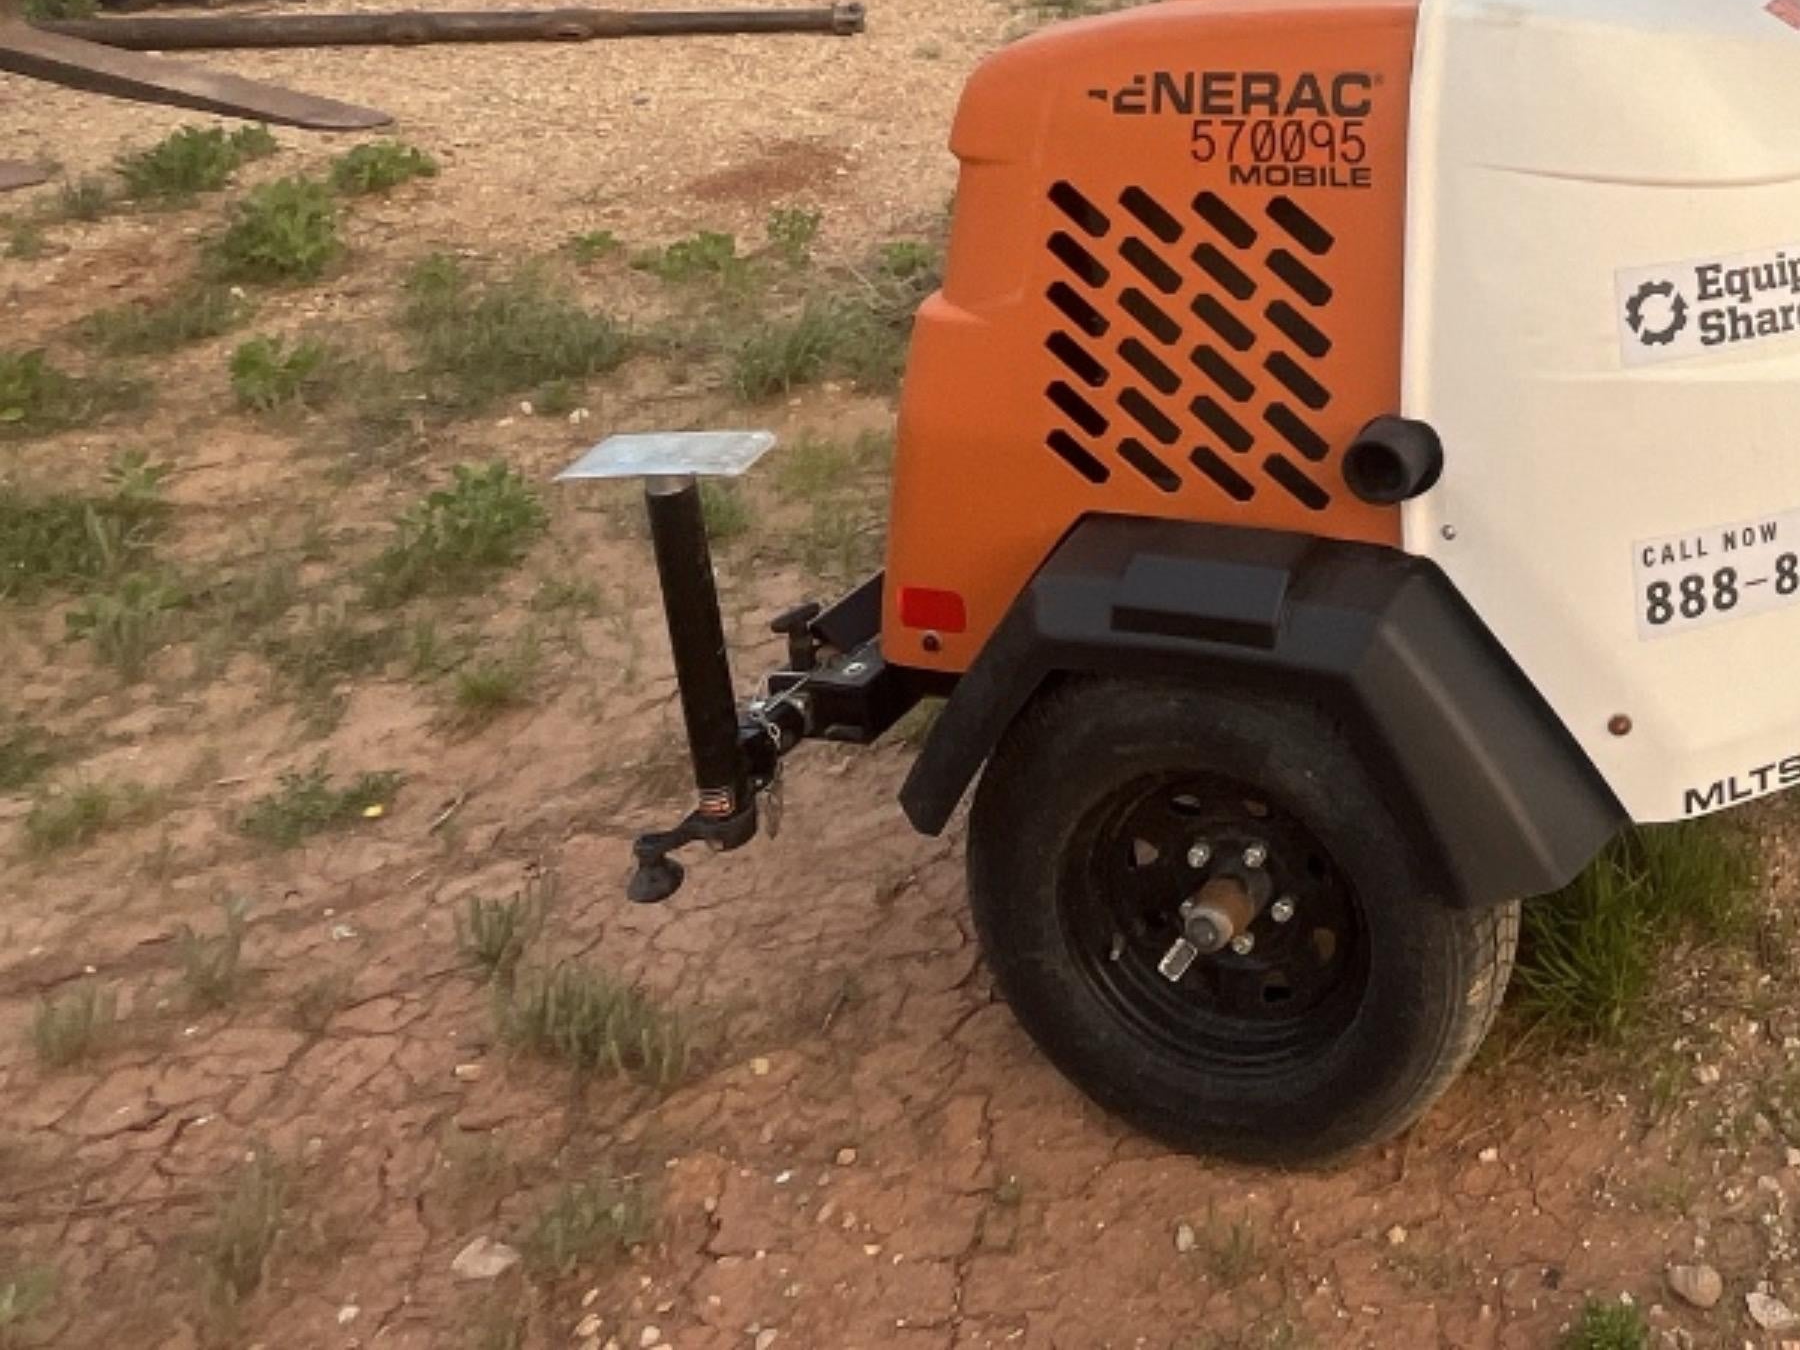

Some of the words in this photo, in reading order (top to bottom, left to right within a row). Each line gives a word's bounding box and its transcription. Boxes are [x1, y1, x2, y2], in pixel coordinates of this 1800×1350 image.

[1087, 71, 1372, 117] ENERAC
[1190, 119, 1367, 164] 570095
[1229, 164, 1372, 187] MOBILE
[1642, 536, 1709, 568] CALL
[1723, 521, 1779, 554] NOW
